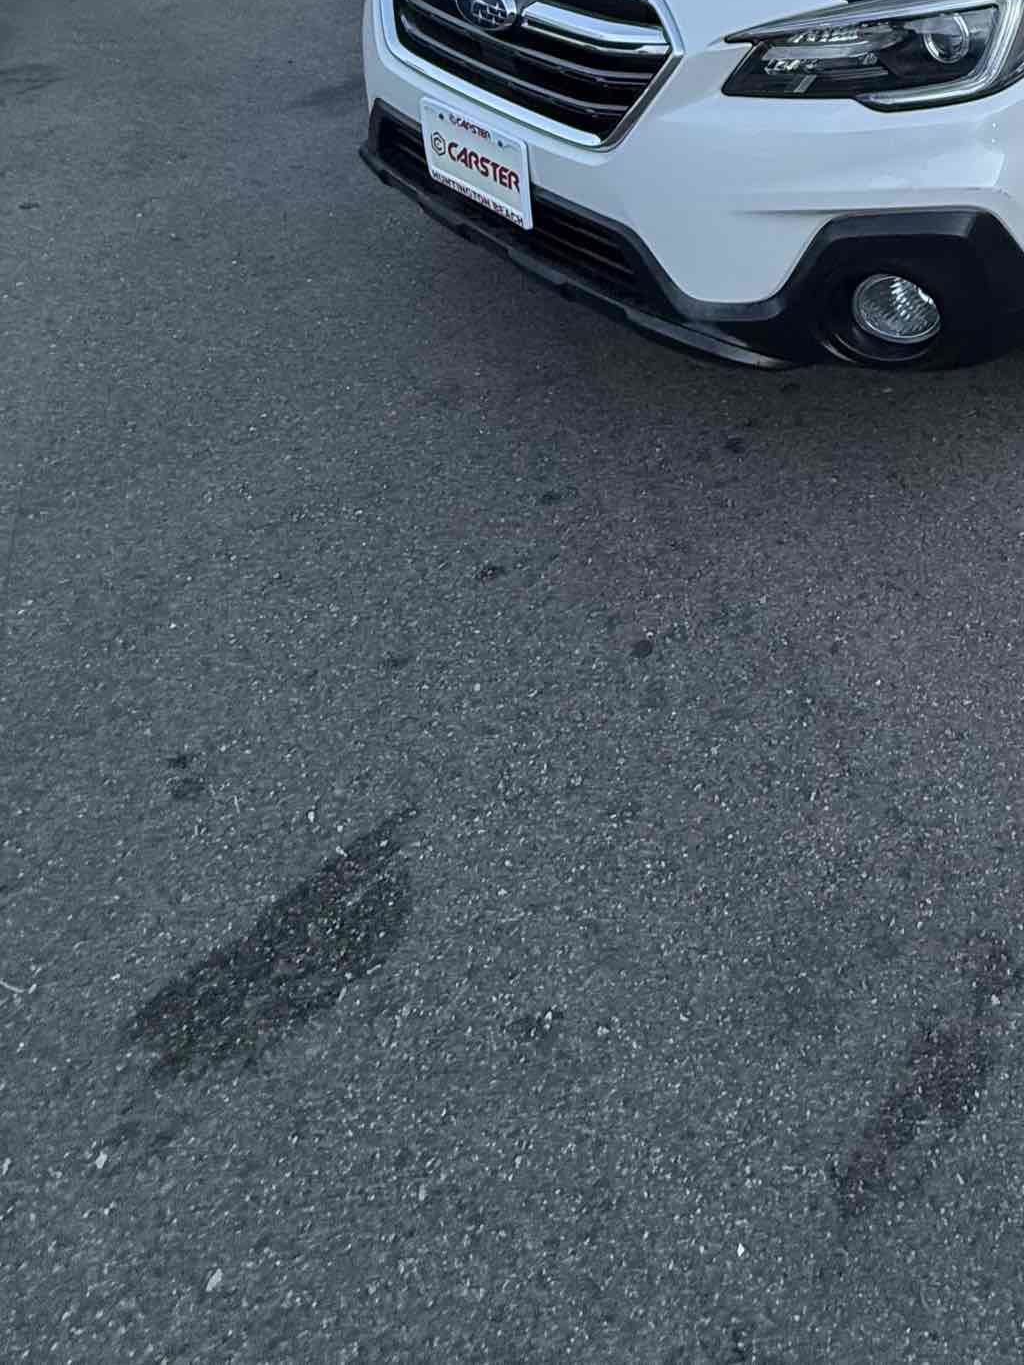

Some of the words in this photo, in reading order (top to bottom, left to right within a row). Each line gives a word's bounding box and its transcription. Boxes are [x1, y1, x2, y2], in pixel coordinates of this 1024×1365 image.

[447, 142, 521, 193] CARSTER
[432, 169, 491, 208] HUNTINGTON
[492, 201, 525, 227] BEACH
